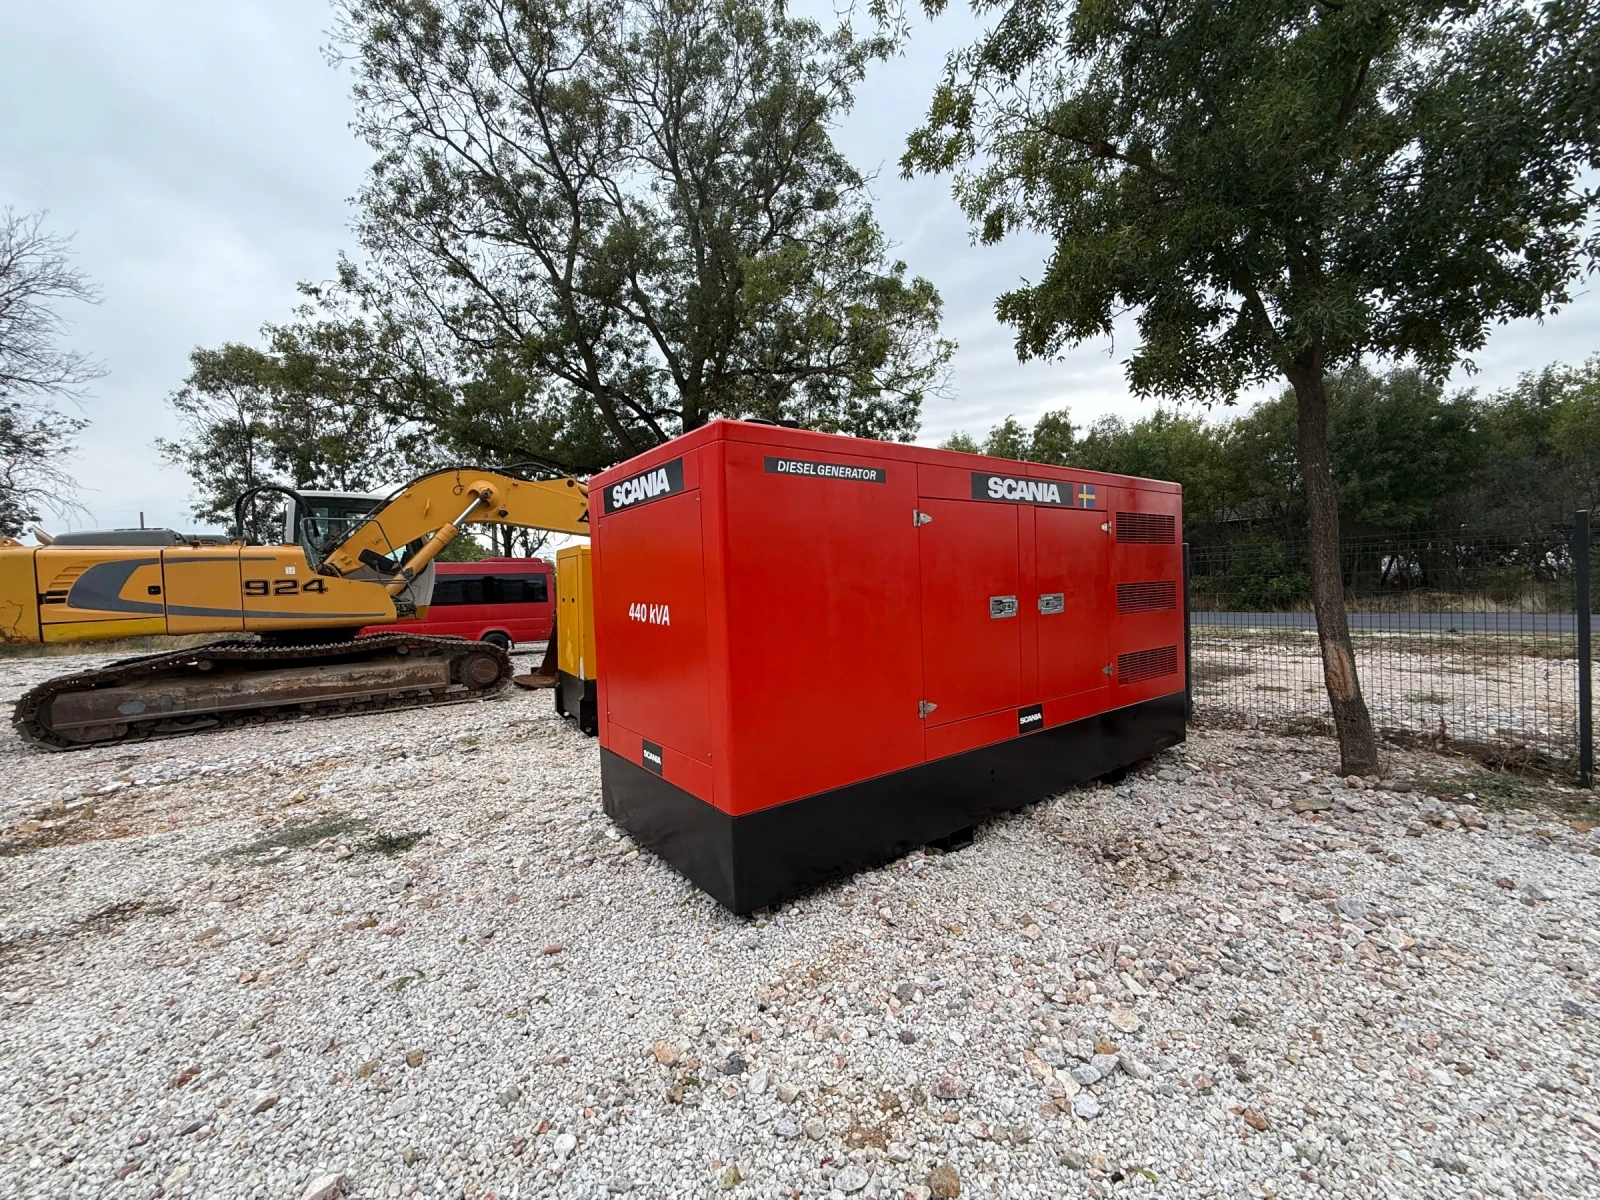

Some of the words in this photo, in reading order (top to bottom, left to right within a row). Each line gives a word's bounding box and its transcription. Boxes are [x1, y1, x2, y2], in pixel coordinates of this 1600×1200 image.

[777, 460, 816, 475] DIESEL
[817, 464, 877, 481] GENERATOR
[612, 468, 670, 508] SCANIA
[987, 477, 1061, 503] SCANIA
[243, 578, 328, 596] 924
[628, 602, 647, 622] 440
[649, 603, 670, 626] kVA
[1019, 712, 1042, 725] SCANIA
[643, 749, 662, 766] SCANIA
